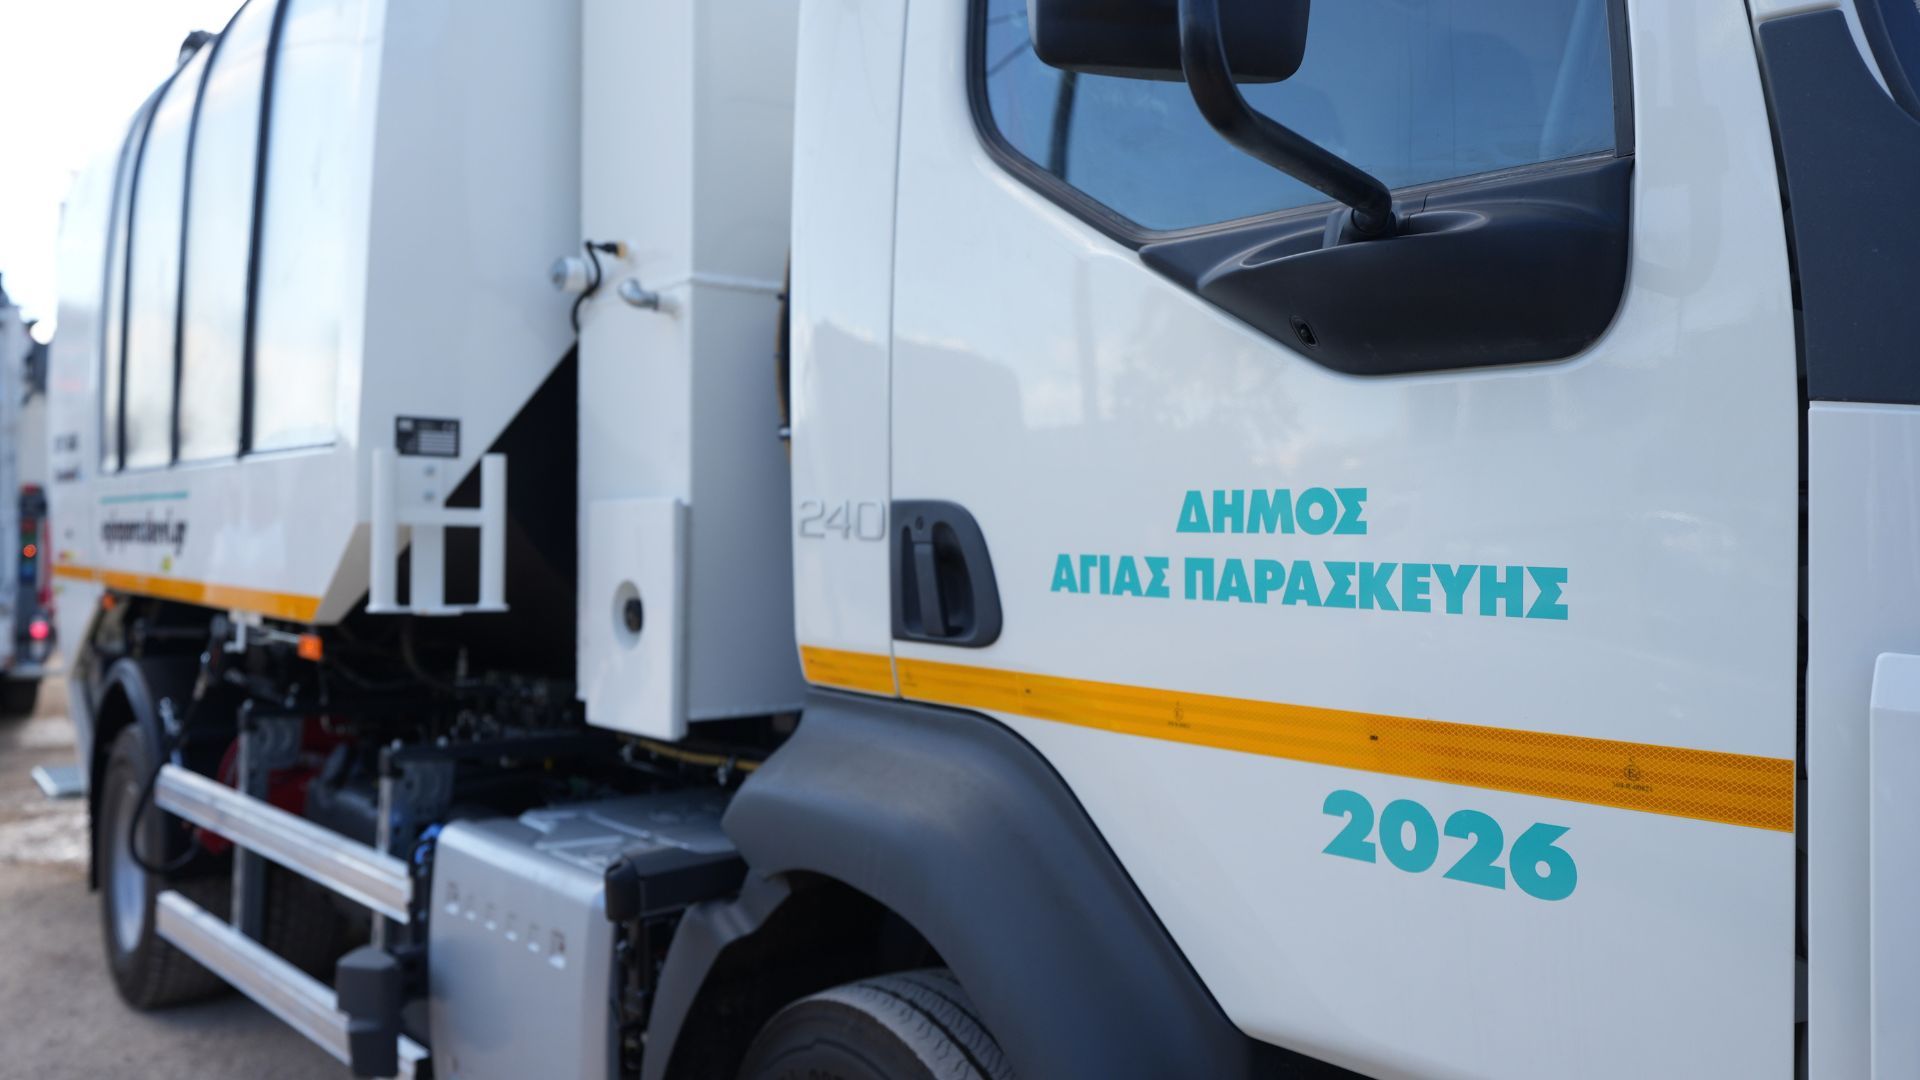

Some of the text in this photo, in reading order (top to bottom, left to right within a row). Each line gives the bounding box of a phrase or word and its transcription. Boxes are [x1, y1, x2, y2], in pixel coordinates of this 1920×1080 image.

[798, 499, 886, 541] 240
[1176, 487, 1368, 536] ΔΗΜΟΣ
[1050, 553, 1569, 621] ΑΓΙΑΣ ΠΑΡΑΣΚΕΥΗΣ
[1322, 789, 1579, 902] 2026
